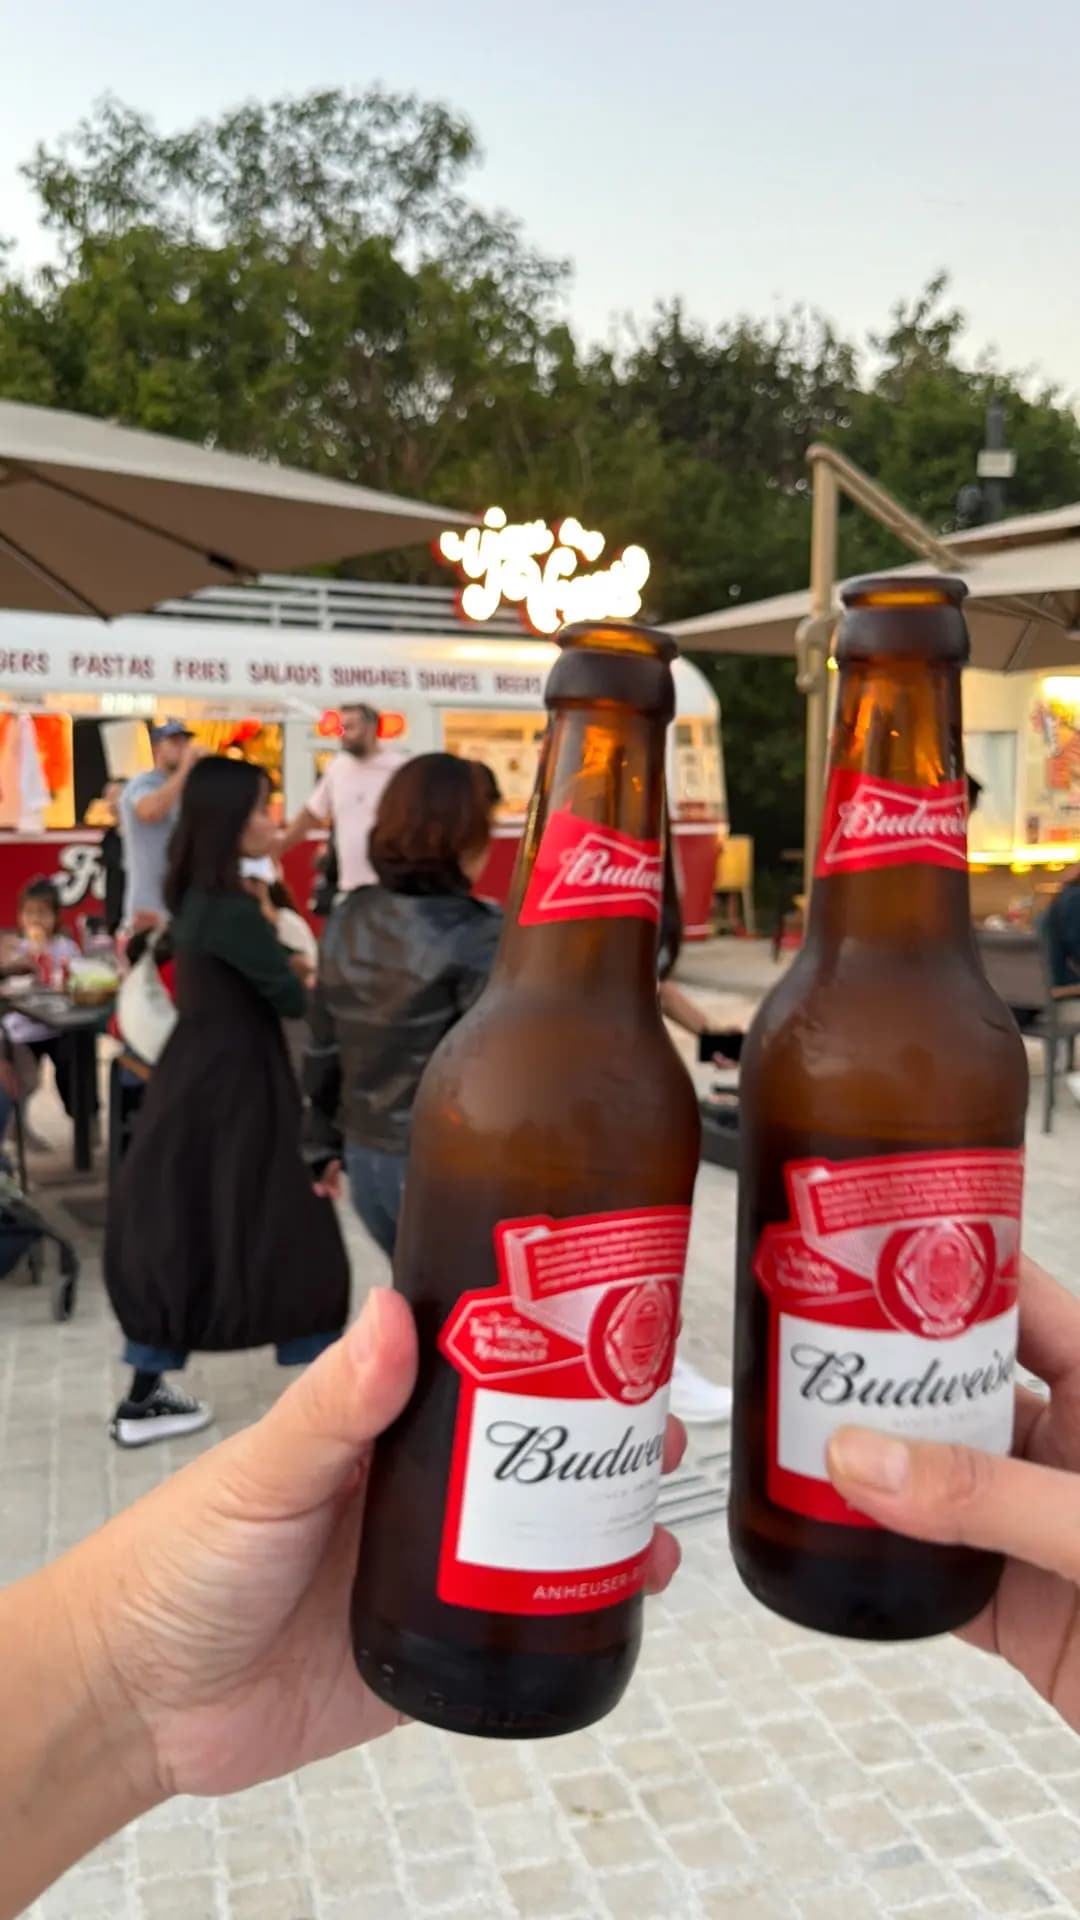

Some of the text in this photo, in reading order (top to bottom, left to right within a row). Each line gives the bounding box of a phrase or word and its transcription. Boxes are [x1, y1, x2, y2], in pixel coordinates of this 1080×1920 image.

[69, 652, 155, 679] PASTAS
[173, 656, 228, 682] FRIES
[248, 660, 322, 686] SALADS
